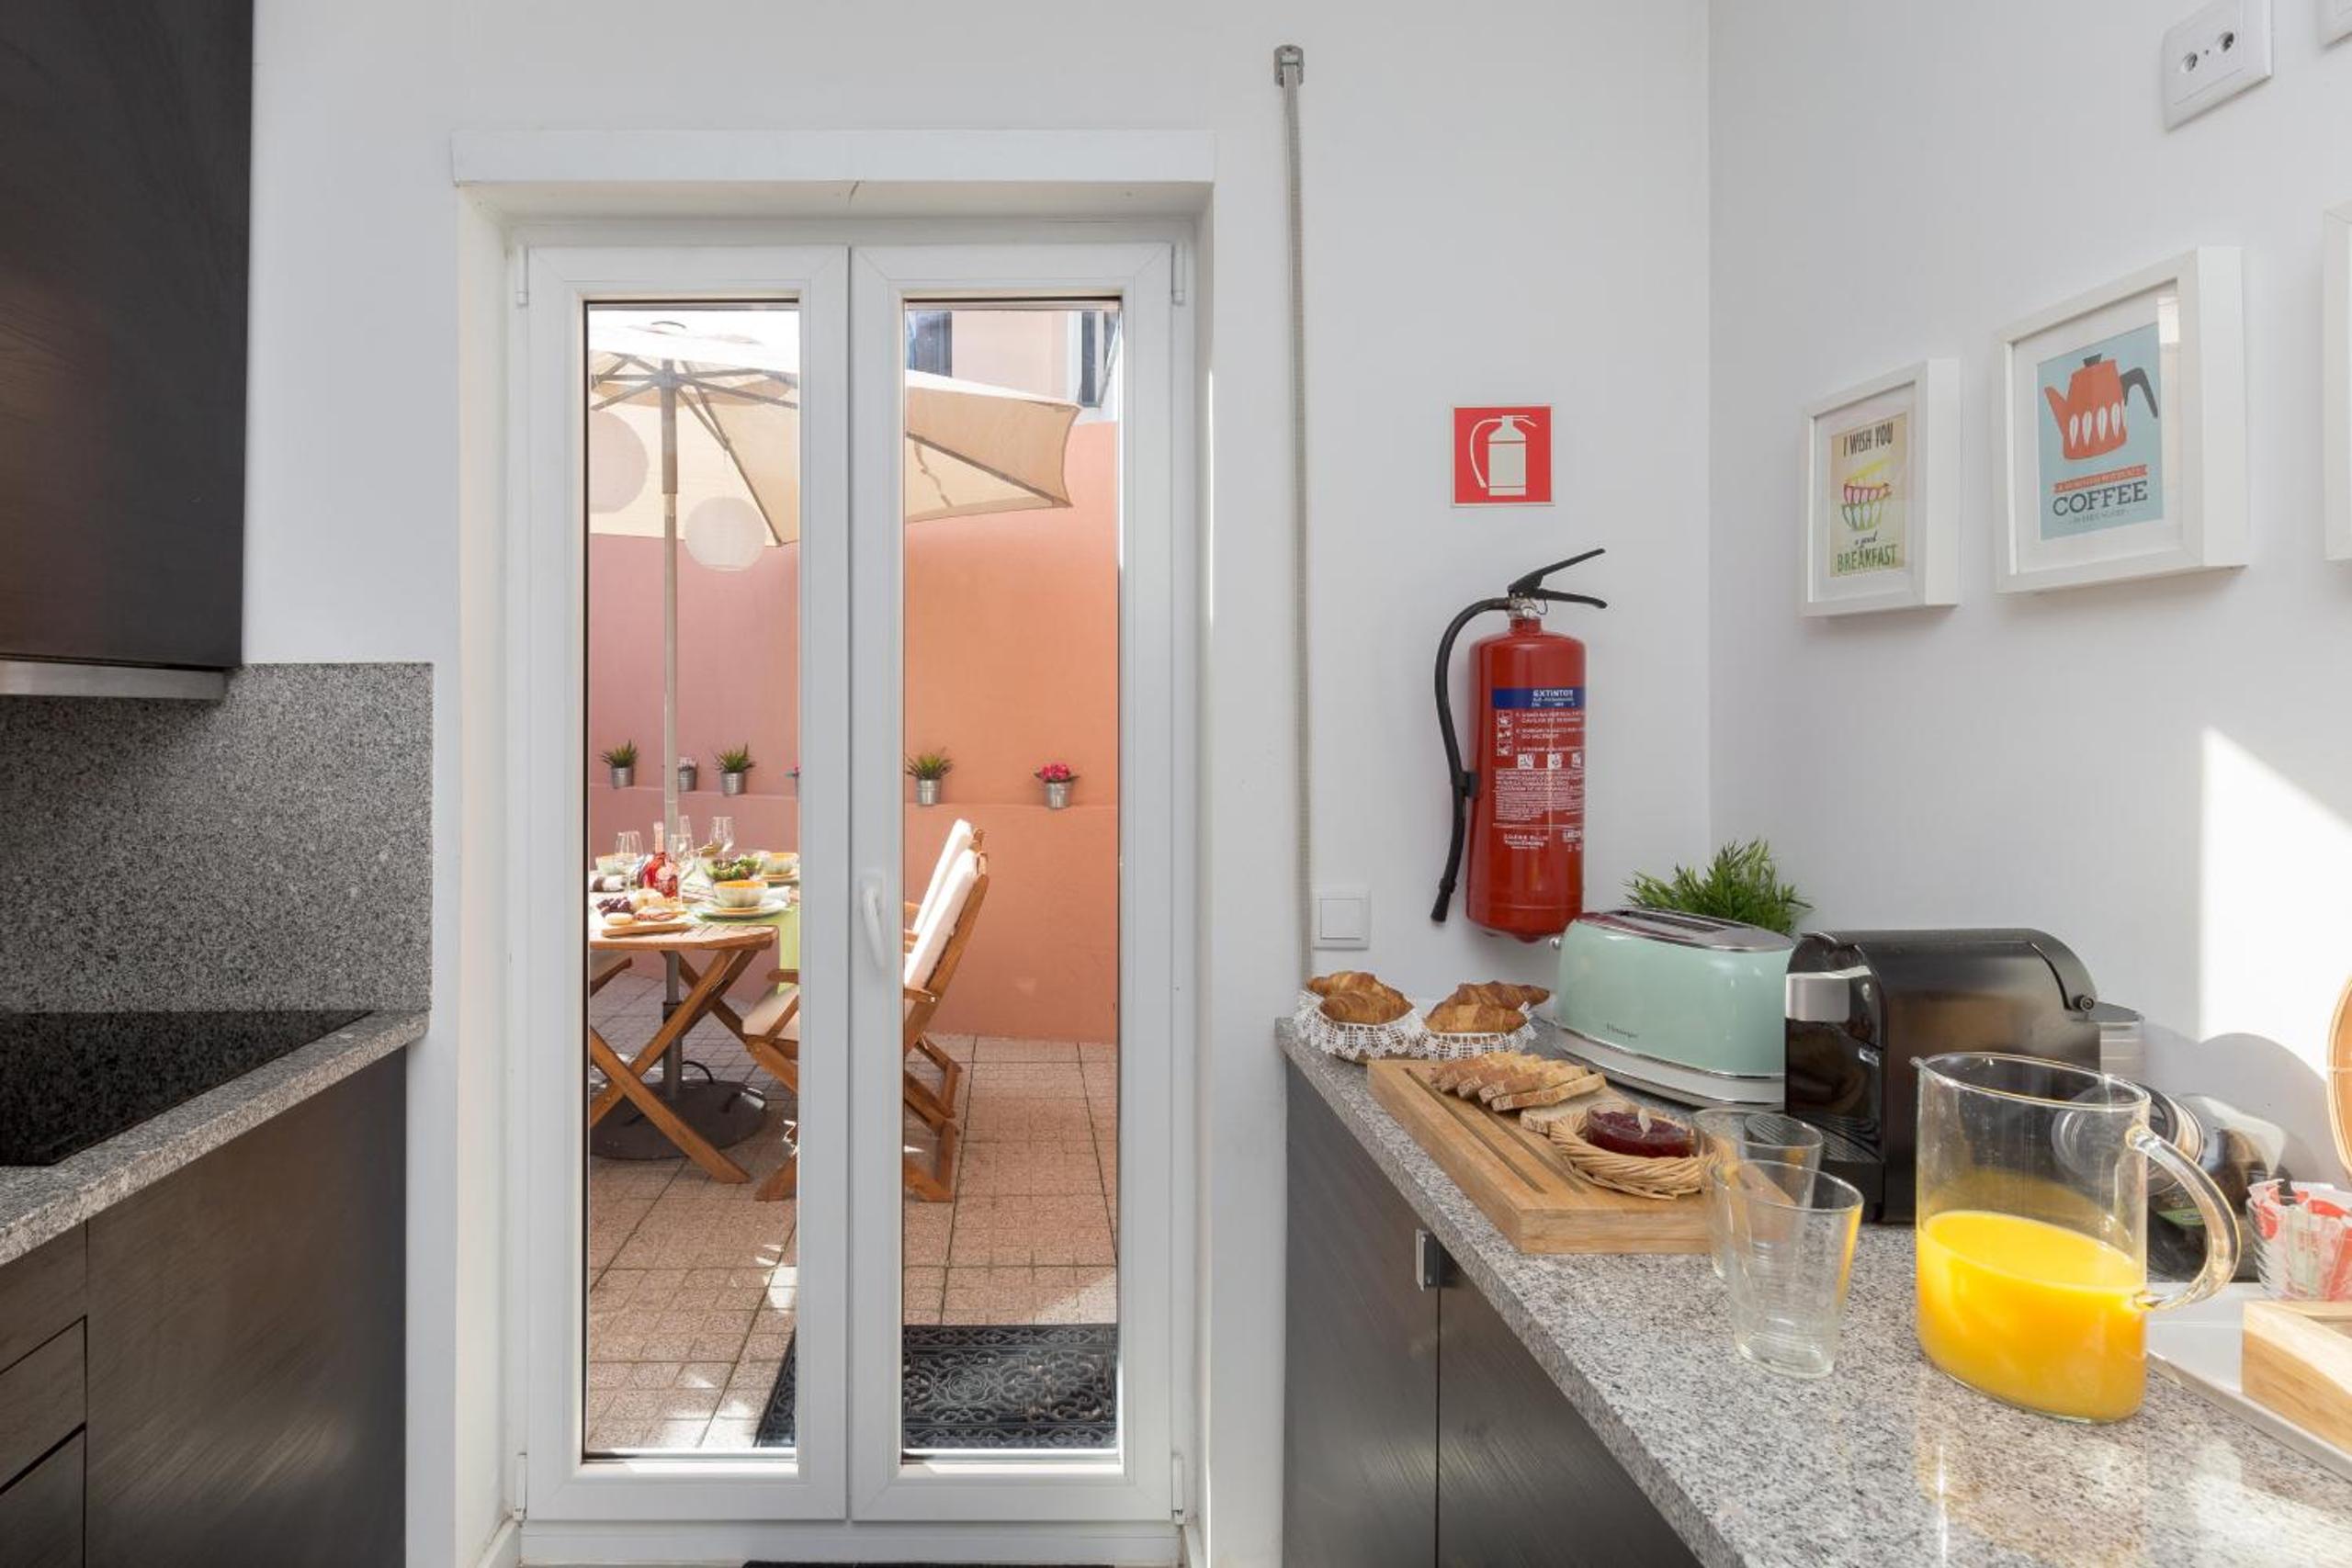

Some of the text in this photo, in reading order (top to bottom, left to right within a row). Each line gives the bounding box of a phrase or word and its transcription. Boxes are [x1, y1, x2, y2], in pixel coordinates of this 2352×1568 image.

[1849, 428, 1872, 455] WISH
[1875, 422, 1894, 449] YOU
[2052, 479, 2147, 516] COFFEE
[1838, 544, 1897, 572] BREAKFAST
